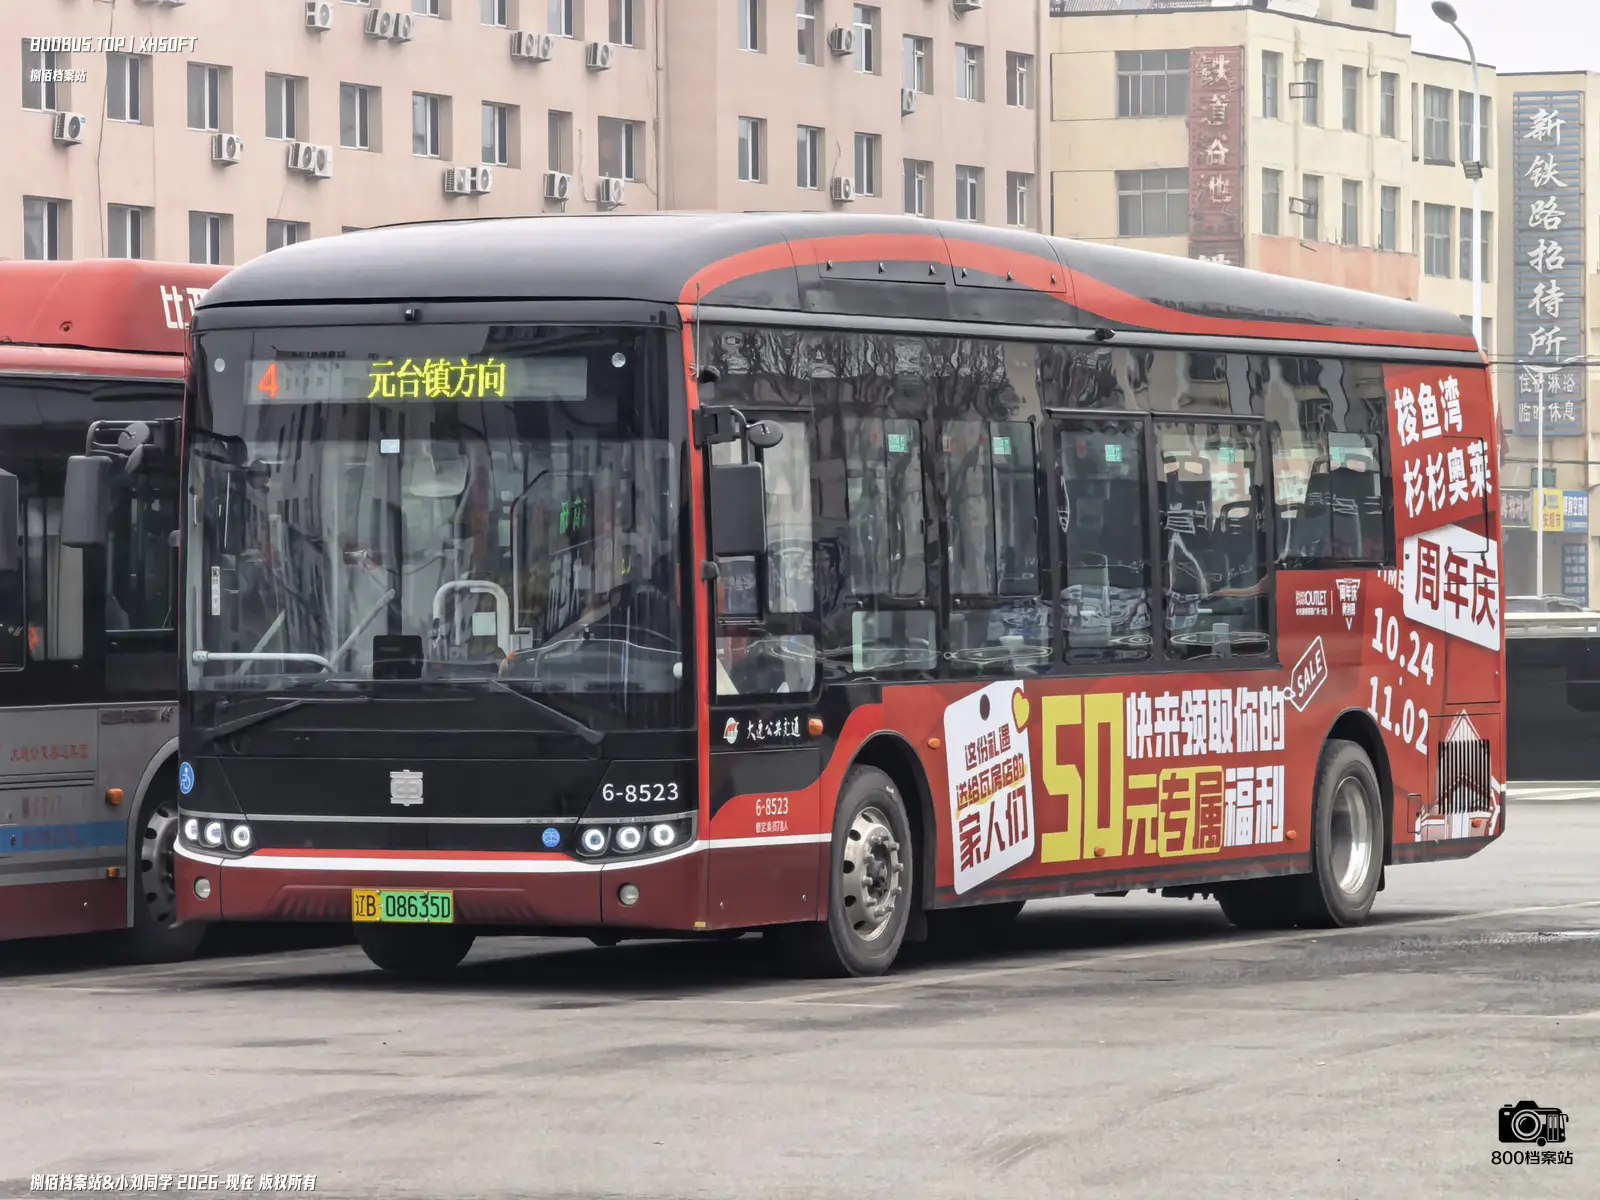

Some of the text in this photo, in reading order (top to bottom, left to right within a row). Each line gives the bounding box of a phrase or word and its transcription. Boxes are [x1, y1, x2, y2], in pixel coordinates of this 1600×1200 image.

[1523, 107, 1568, 363] 新铁路招待所
[258, 362, 279, 399] 4
[367, 357, 506, 399] 元台镇方向
[1394, 375, 1464, 447] 梭鱼湾
[1402, 439, 1493, 518] 杉杉奥莱
[1416, 537, 1496, 631] 周年庆
[1297, 648, 1323, 698] SALE
[1371, 607, 1434, 686] 10.24
[964, 723, 1011, 771] 这份礼遇
[1126, 686, 1285, 759] 快来领取你的
[1367, 676, 1429, 756] 11.02
[602, 782, 679, 803] 6-8523
[756, 797, 789, 816] 6-8523
[956, 752, 1025, 811] 送给瓦房店的
[959, 785, 1029, 873] 家人们
[356, 894, 451, 918] 辽B 08635D
